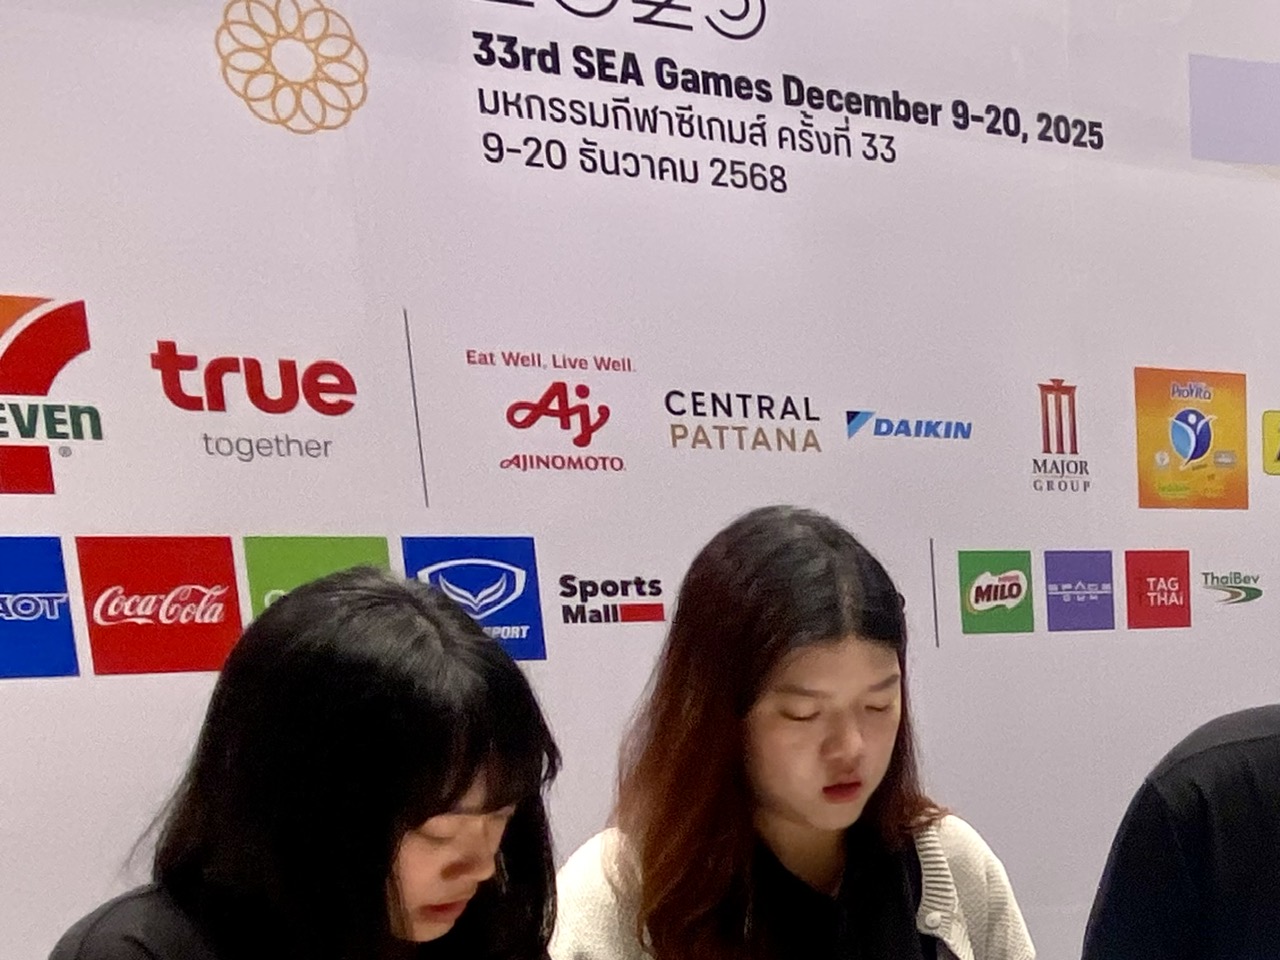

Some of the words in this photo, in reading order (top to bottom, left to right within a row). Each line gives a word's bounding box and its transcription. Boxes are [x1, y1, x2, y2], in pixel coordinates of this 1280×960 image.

[472, 31, 561, 75] 33rd
[573, 44, 645, 87] SEA
[655, 57, 773, 102] Games
[783, 74, 942, 127] December
[1037, 112, 1104, 150] 2025
[478, 88, 767, 148] มหกรรมกีฬาซีเกมส์
[778, 110, 852, 158] ครั้งที่
[862, 132, 896, 163] 33
[483, 132, 567, 169] 9-20
[579, 138, 699, 184] ธันวาคม
[709, 157, 788, 193] 2568
[466, 350, 496, 366] Eat
[552, 354, 588, 370] Live
[150, 340, 357, 416] true
[664, 390, 820, 421] CENTRAL
[670, 424, 822, 452] PATTANA
[873, 418, 973, 439] DAIKIN
[203, 433, 333, 462] together
[500, 455, 625, 471] AJINOMOTO
[1032, 459, 1090, 478] MAJOR
[1033, 479, 1091, 492] GROUP
[559, 574, 662, 602] Sports
[1146, 577, 1179, 591] TAG
[1201, 572, 1260, 585] ThaiBev
[93, 585, 228, 625] Coca-Cola
[974, 582, 1022, 604] MILO
[562, 603, 619, 624] Mall
